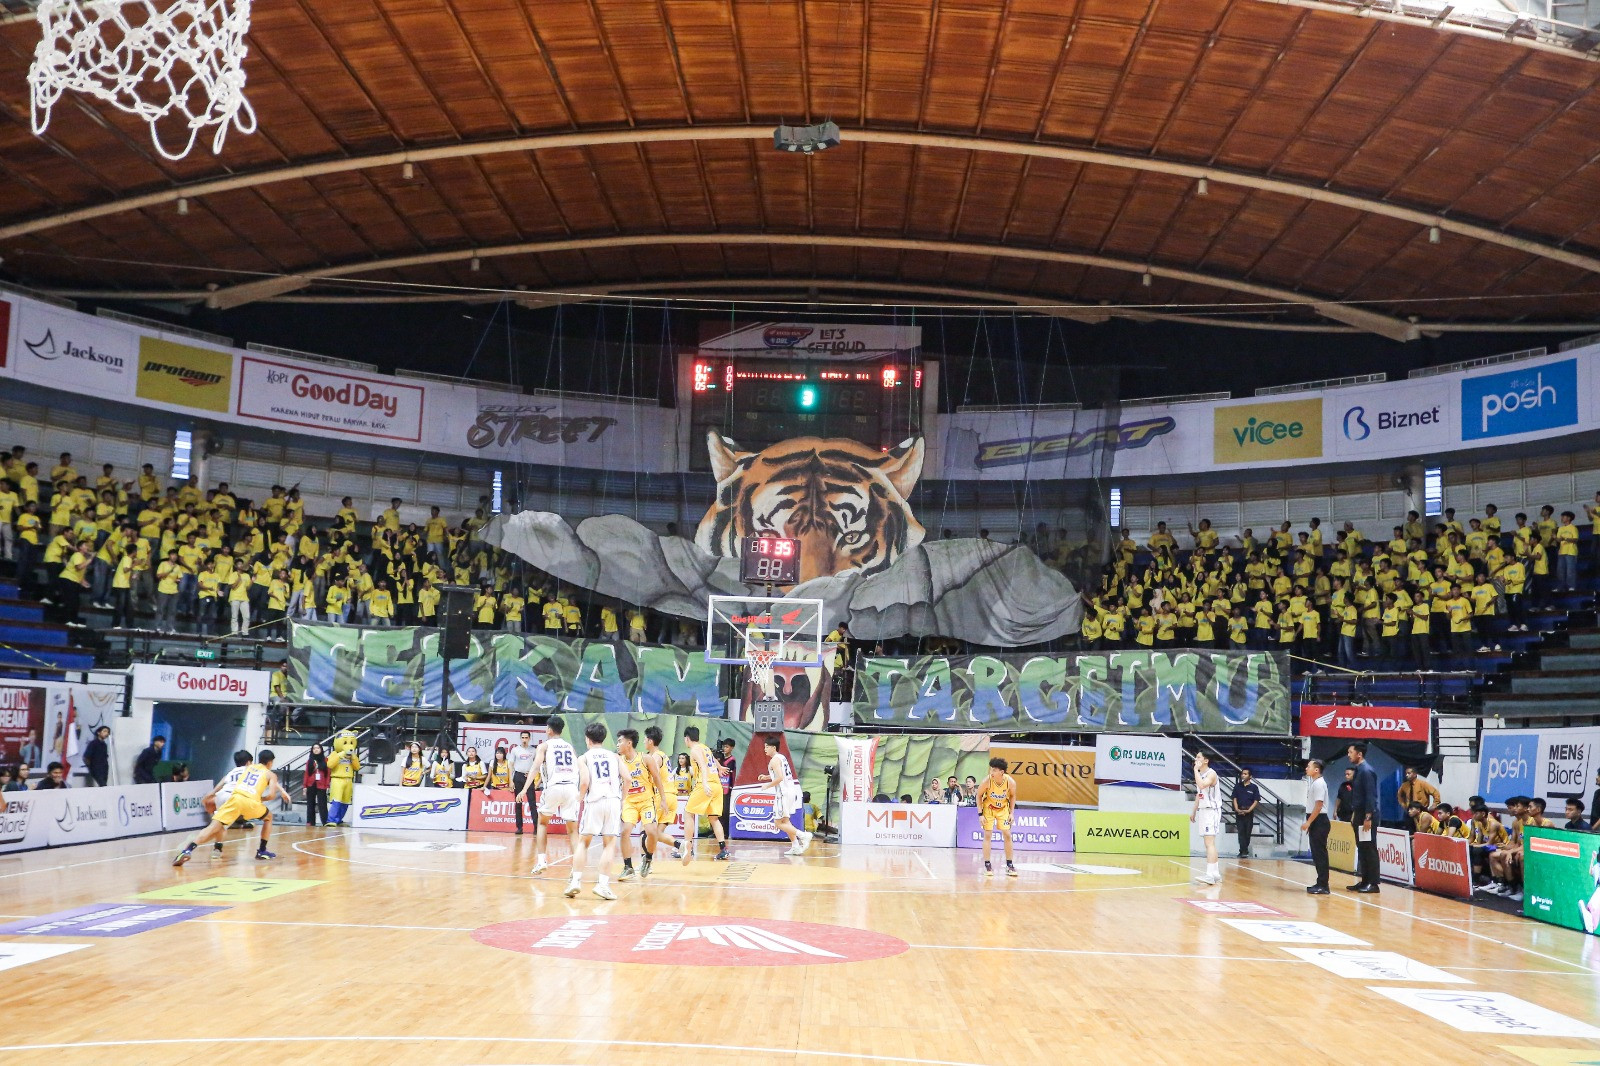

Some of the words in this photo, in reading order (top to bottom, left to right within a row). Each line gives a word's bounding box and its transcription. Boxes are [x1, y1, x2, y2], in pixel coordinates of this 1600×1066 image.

[820, 328, 846, 340] LET'S
[62, 341, 124, 367] Jackson
[143, 361, 224, 385] proteam
[1481, 372, 1557, 433] posh
[270, 406, 299, 417] KARENA
[1377, 406, 1440, 430] Biznet
[196, 650, 213, 658] EXIT
[1335, 717, 1413, 732] HONDA
[553, 750, 573, 766] 26
[1122, 749, 1133, 759] RS
[1134, 750, 1166, 761] UBAYA
[593, 760, 610, 779] 13
[1486, 744, 1528, 794] posh
[1547, 762, 1582, 785] Bioré
[243, 771, 260, 786] 15
[76, 805, 108, 822] Jackson
[130, 802, 153, 818] Biznet
[875, 832, 924, 840] DISTRIBUTOR
[1027, 834, 1058, 843] BLAST
[1086, 827, 1180, 840] AZAWEAR.COM
[1428, 857, 1465, 877] HONDA
